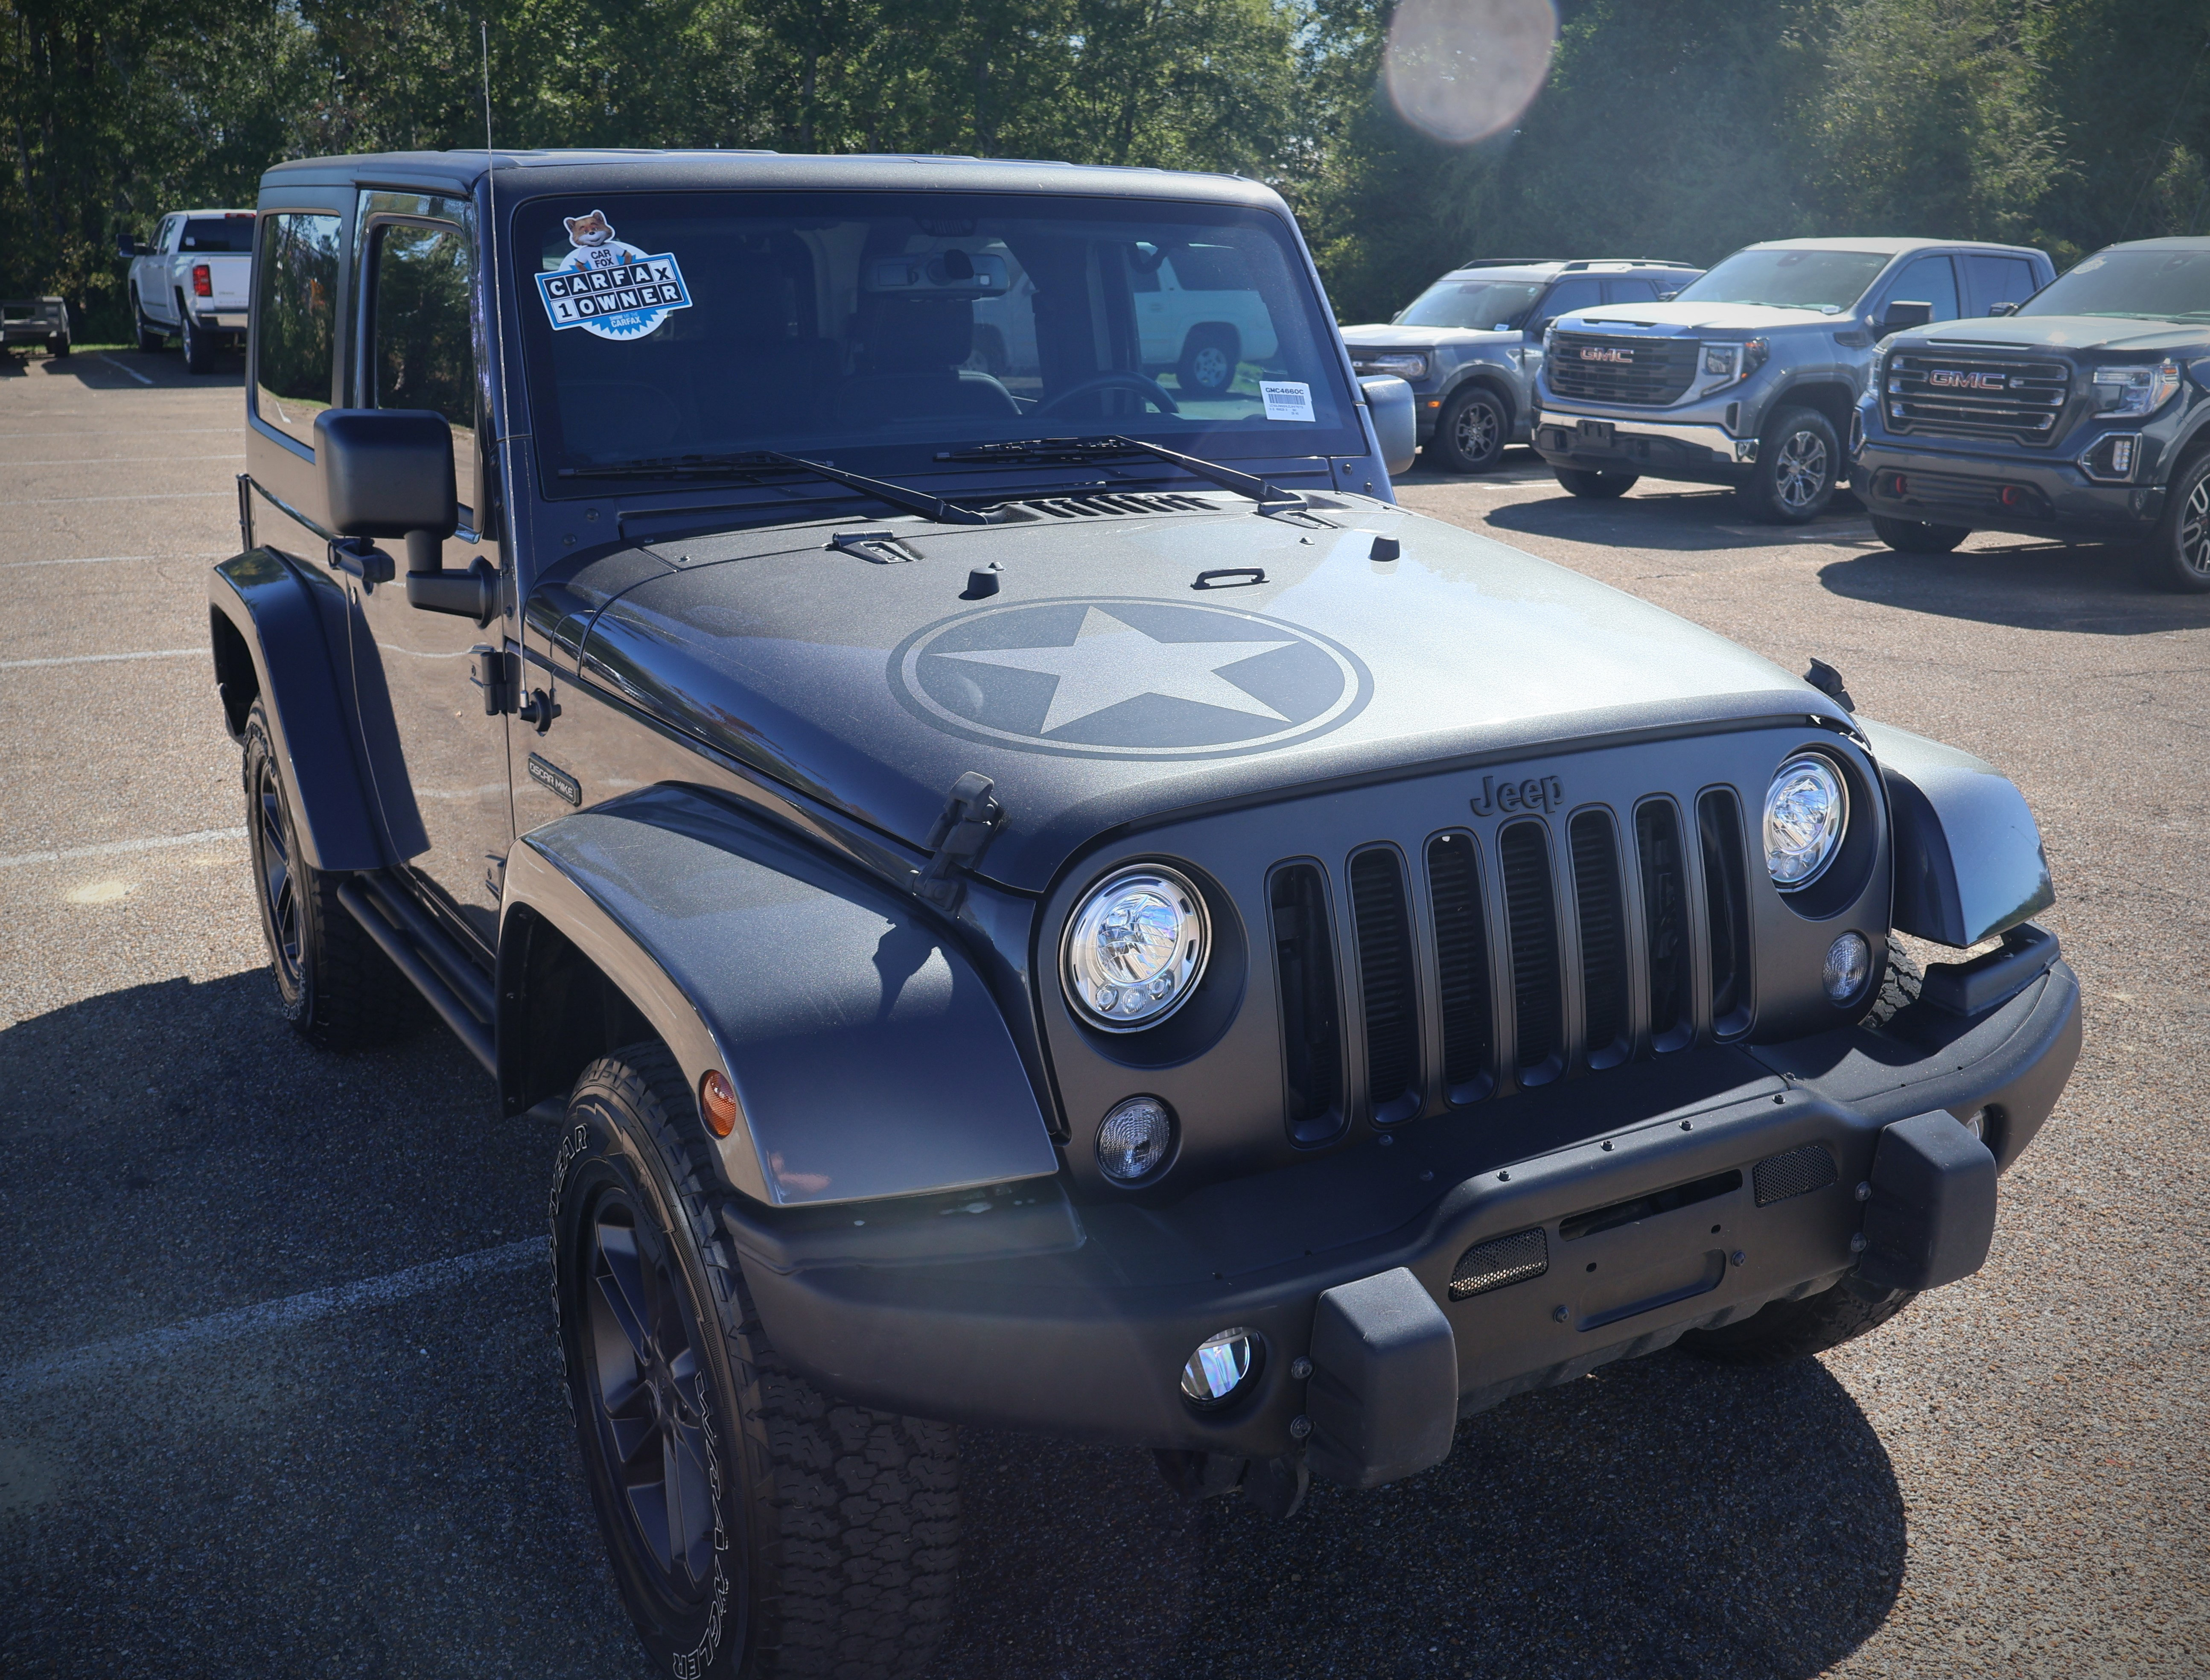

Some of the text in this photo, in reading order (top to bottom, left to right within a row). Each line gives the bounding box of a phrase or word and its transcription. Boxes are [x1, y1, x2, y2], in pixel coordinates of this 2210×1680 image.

[591, 249, 611, 259] CAR
[595, 257, 614, 268] FOX
[550, 267, 672, 296] CARFAX
[611, 316, 641, 327] CARFAX
[1580, 346, 1634, 363] GMC
[1930, 370, 2006, 390] GMC
[529, 762, 573, 798] OSCAR MIKE
[1470, 775, 1565, 817] Jeep
